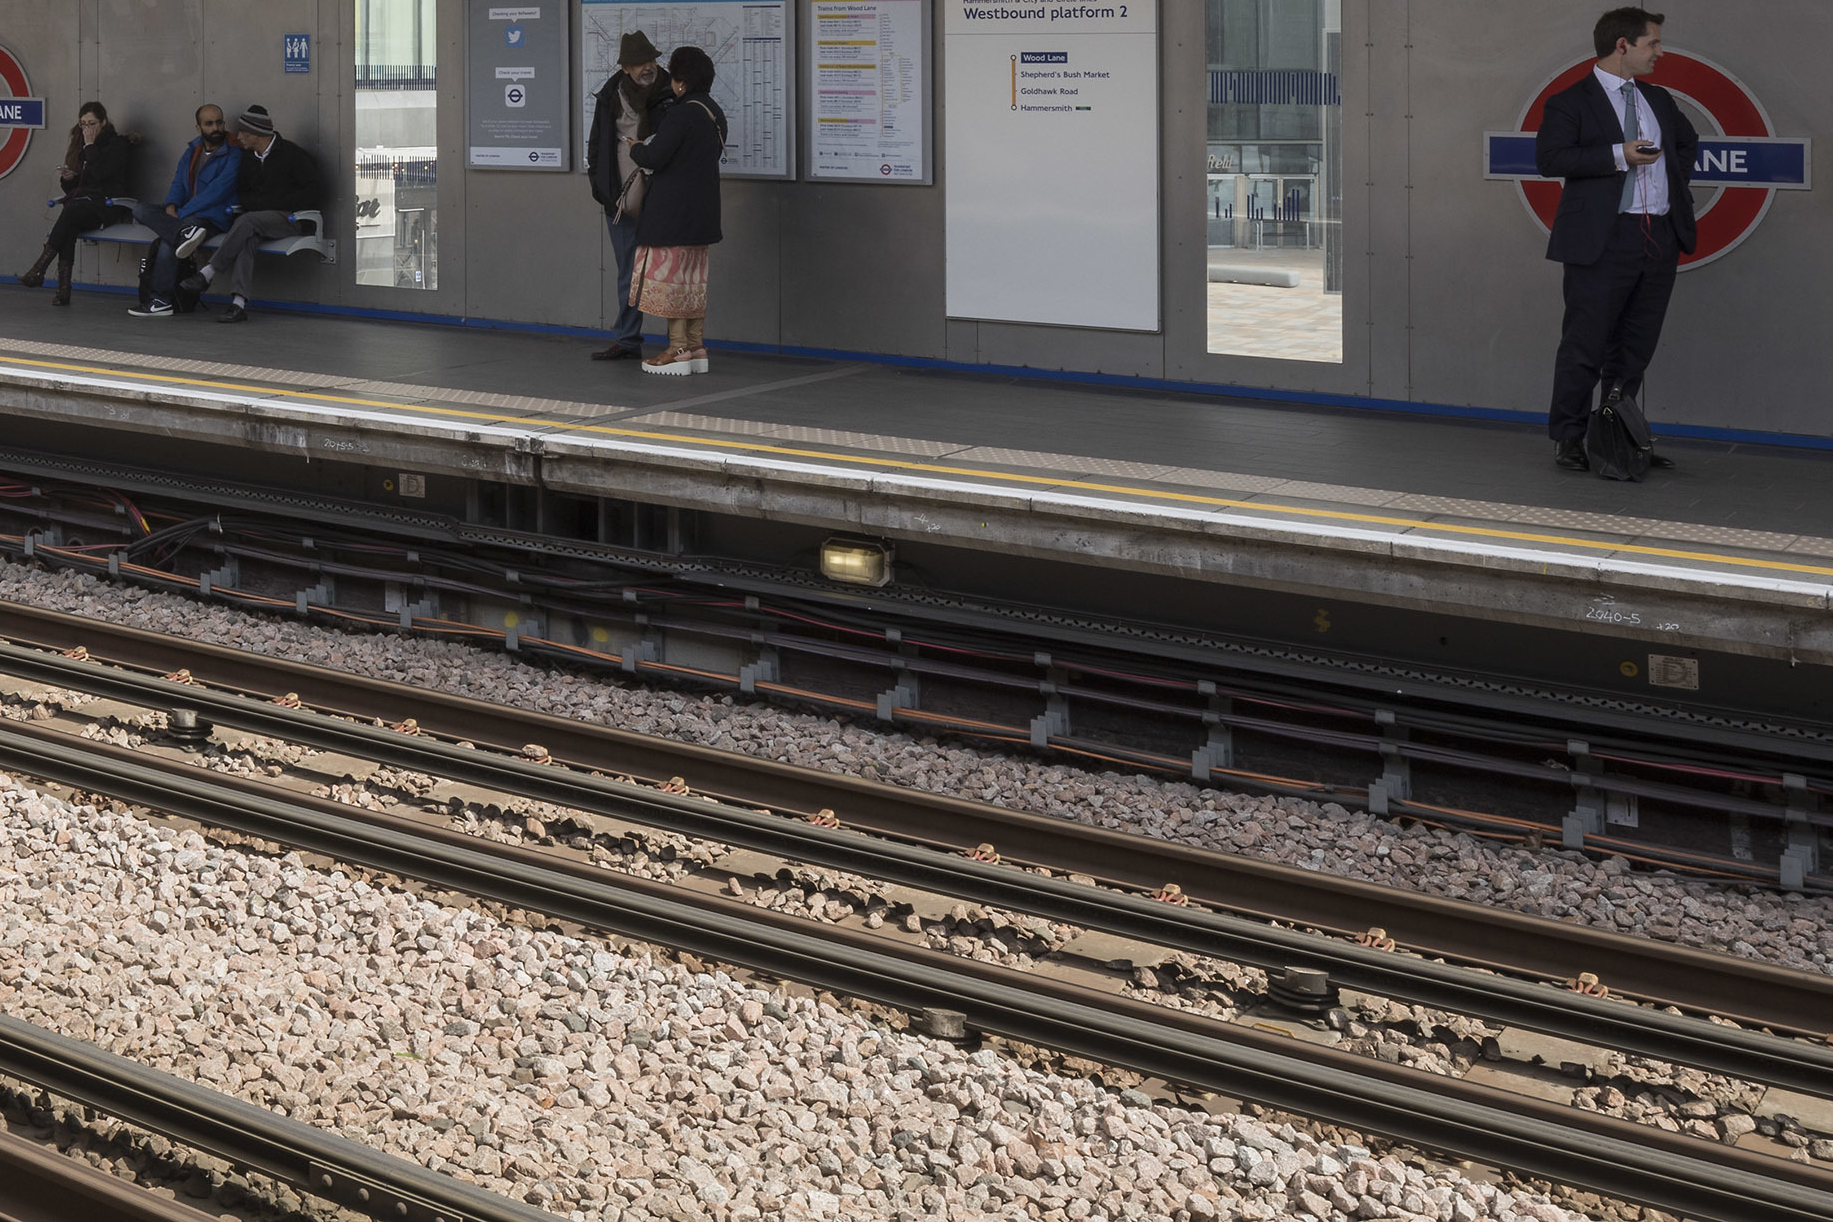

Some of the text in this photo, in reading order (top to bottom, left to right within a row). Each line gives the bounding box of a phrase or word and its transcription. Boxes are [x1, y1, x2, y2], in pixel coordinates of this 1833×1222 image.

[963, 5, 1128, 21] Westbound platform 2
[1020, 71, 1061, 79] Shepherd's
[1694, 150, 1748, 173] NE
